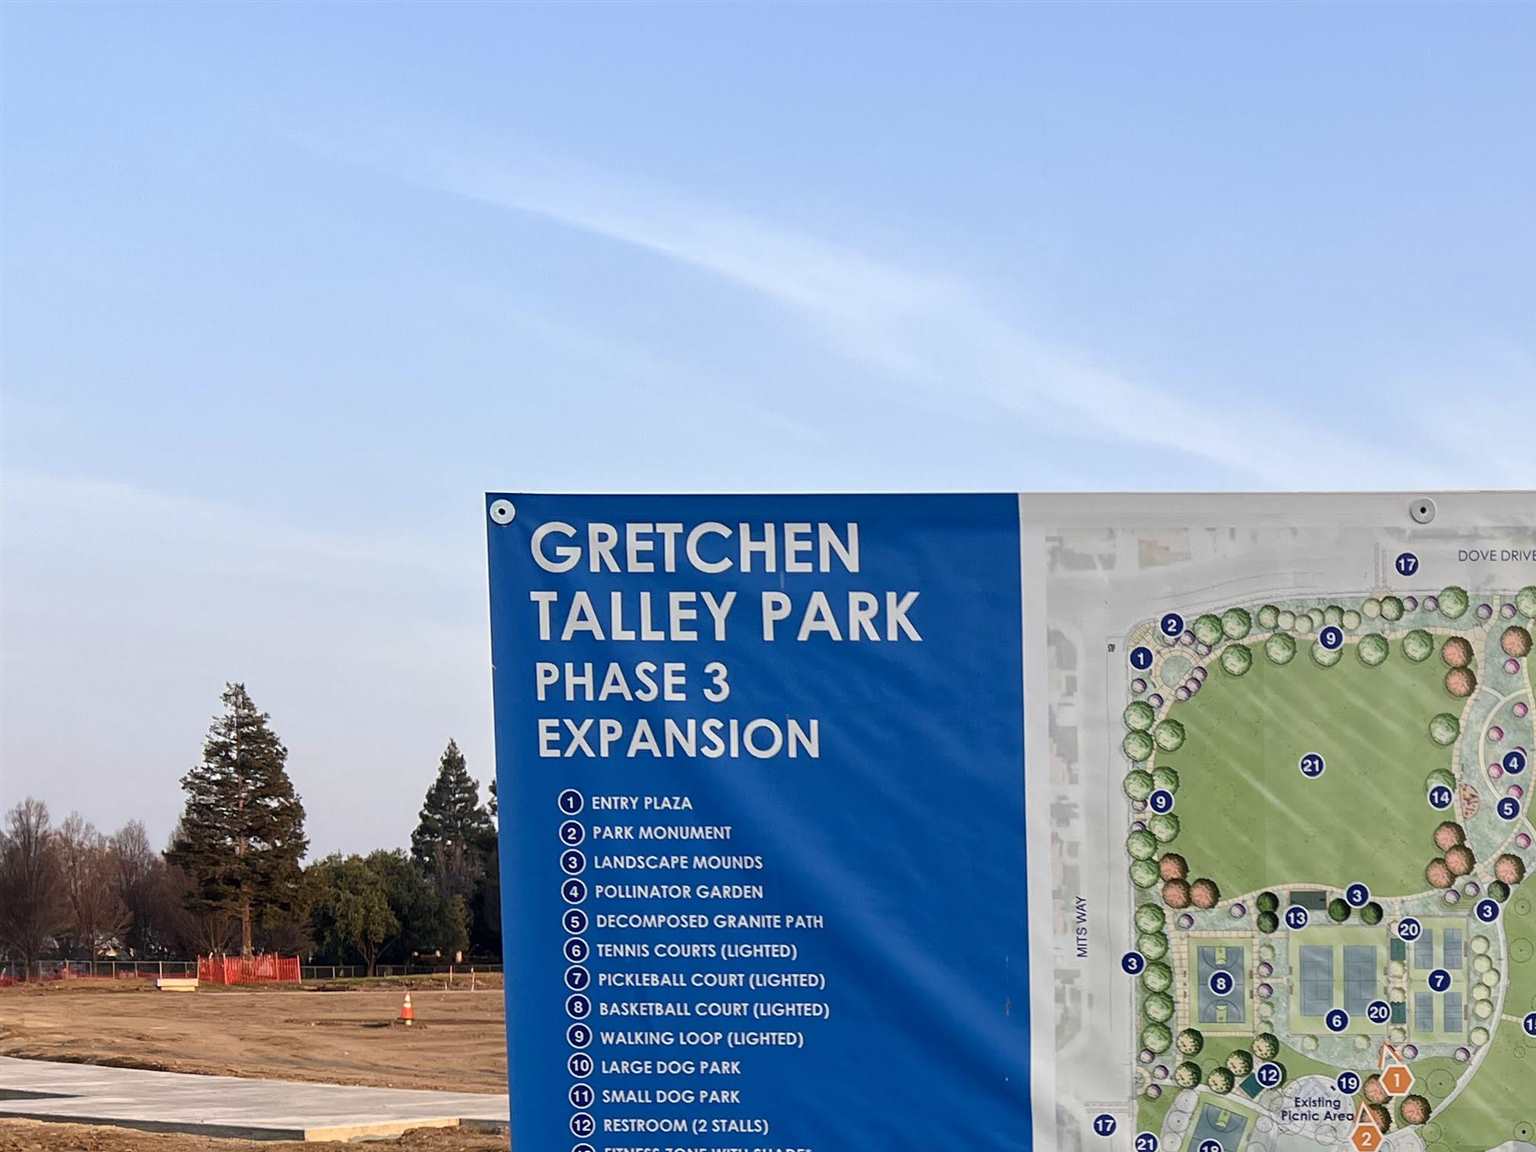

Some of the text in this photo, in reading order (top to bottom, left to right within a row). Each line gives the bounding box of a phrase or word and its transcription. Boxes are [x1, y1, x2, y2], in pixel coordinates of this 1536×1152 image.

[531, 522, 859, 573] GRETCHEN
[1459, 550, 1496, 561] DOVE
[530, 591, 922, 641] TALLEY PARK
[536, 662, 729, 702] PHASE 3
[539, 719, 819, 758] EXPANSION
[592, 797, 638, 809] ENTRY
[645, 797, 692, 809] PLAZA
[593, 826, 633, 839] PARK
[639, 826, 731, 839] MONUMENT
[595, 856, 688, 869] LANDSCAPE
[693, 856, 763, 869] MOUNDS
[596, 885, 691, 898] POLLINATOR
[696, 885, 763, 898] GARDEN
[597, 915, 708, 928] DECOMPOSED
[714, 915, 781, 928] GRANITE
[786, 915, 823, 928] PATH
[1076, 896, 1088, 958] MITS WAY
[597, 944, 649, 957] TENNIS
[654, 944, 716, 957] COURTS
[721, 944, 797, 960] (LIGHTED)
[599, 973, 687, 986] PICKLEBALL
[691, 974, 744, 986] COURT
[749, 974, 825, 989] (LIGHTED)
[600, 1003, 691, 1015] BASKETBALL
[695, 1003, 749, 1016] COURT
[754, 1003, 829, 1019] (LIGHTED)
[600, 1032, 674, 1045] WALKING
[680, 1032, 722, 1045] LOOP
[728, 1032, 803, 1048] (LIGHTED)
[602, 1061, 652, 1073] LARGE
[657, 1061, 695, 1074] DOG
[700, 1061, 740, 1074] PARK
[603, 1090, 652, 1103] SMALL
[657, 1090, 694, 1103] DOG
[700, 1091, 740, 1103] PARK
[1294, 1098, 1340, 1109] Existing
[1281, 1111, 1354, 1121] Picnic Area
[604, 1119, 687, 1132] RESTROOM
[693, 1119, 707, 1135] (2
[712, 1120, 768, 1135] STALLS)
